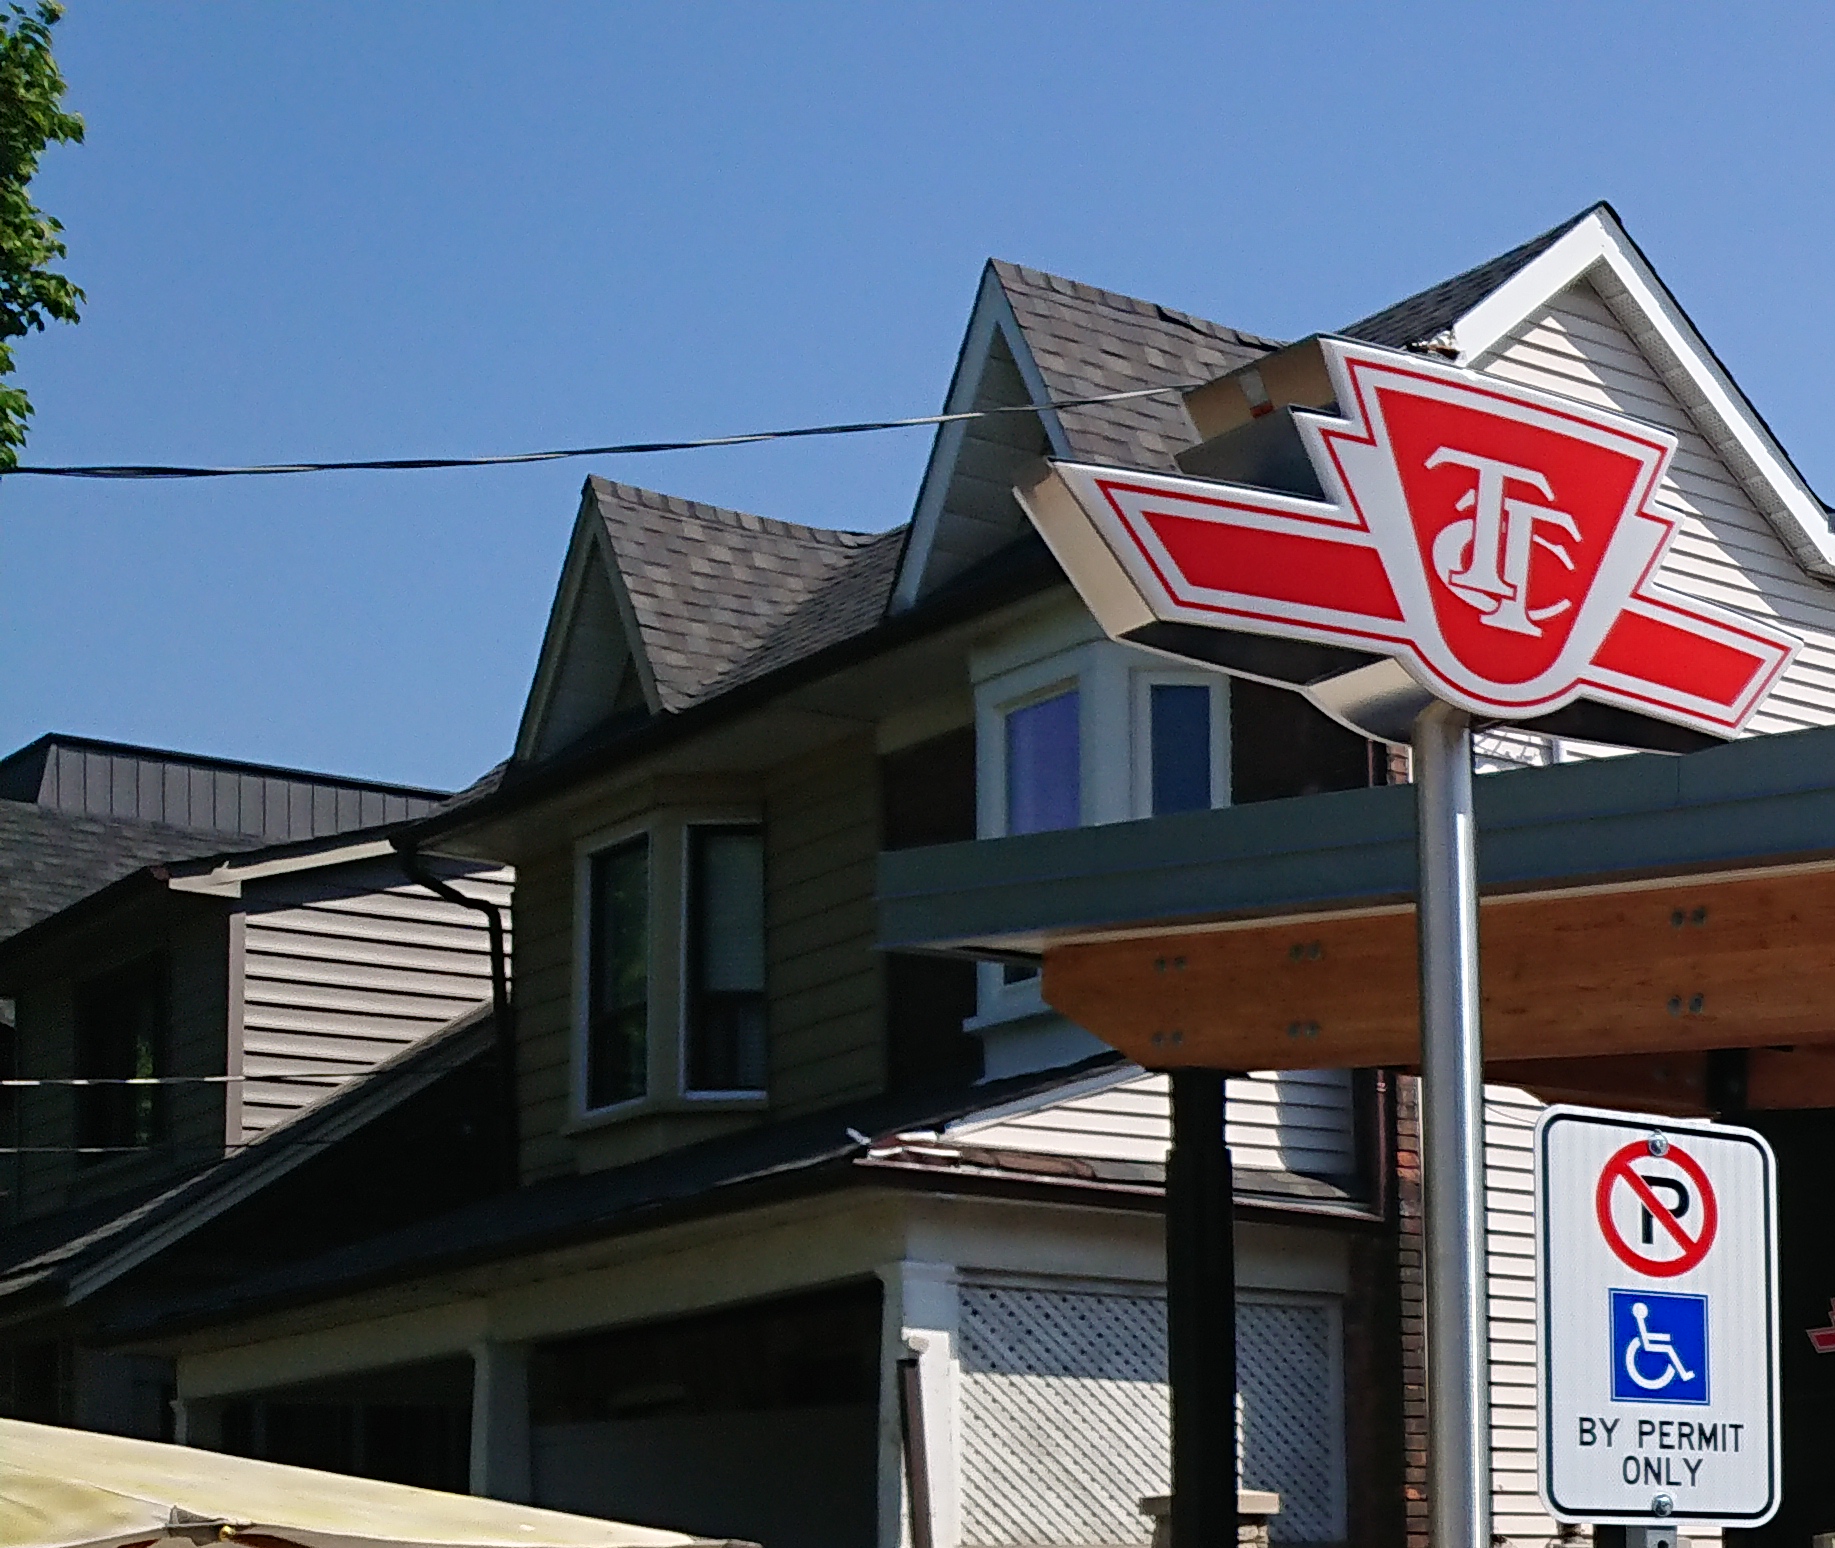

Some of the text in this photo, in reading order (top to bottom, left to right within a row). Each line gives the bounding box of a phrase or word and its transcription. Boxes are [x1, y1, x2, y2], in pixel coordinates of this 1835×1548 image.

[1578, 1417, 1744, 1453] BY PERMIT
[1623, 1455, 1703, 1487] ONLY
